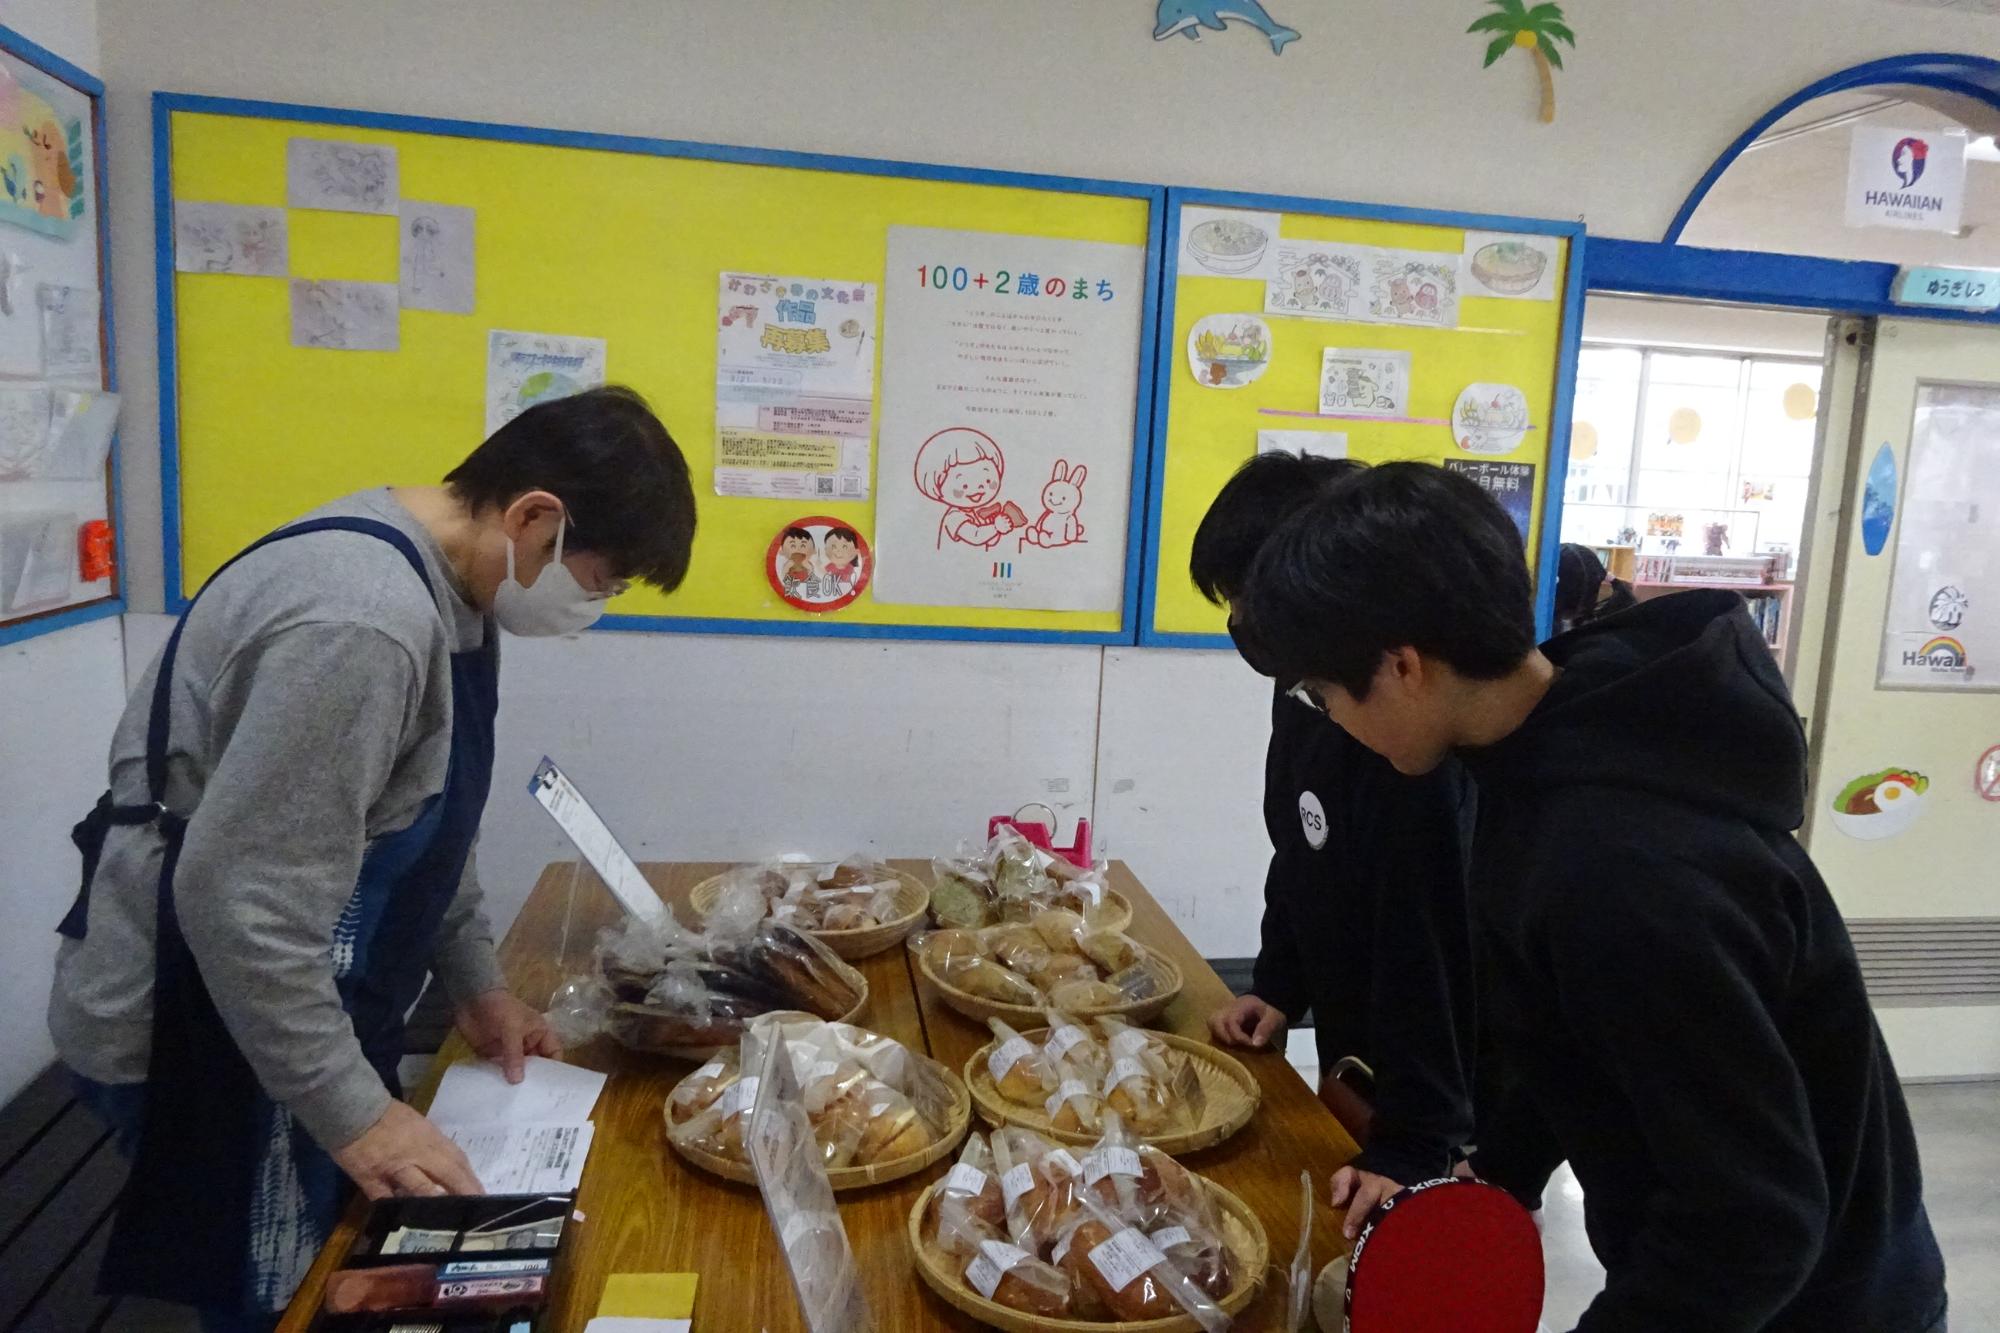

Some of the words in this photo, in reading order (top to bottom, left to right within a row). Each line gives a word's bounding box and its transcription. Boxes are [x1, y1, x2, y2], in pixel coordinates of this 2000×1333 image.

[1865, 190, 1943, 212] HAWAIIAN
[917, 264, 1114, 301] 100+2歳のまち
[1926, 279, 1986, 299] ゆうぎしつ
[775, 299, 816, 325] 作品
[1408, 1175, 1460, 1194] XIOM
[1349, 1222, 1375, 1273] XIOM
